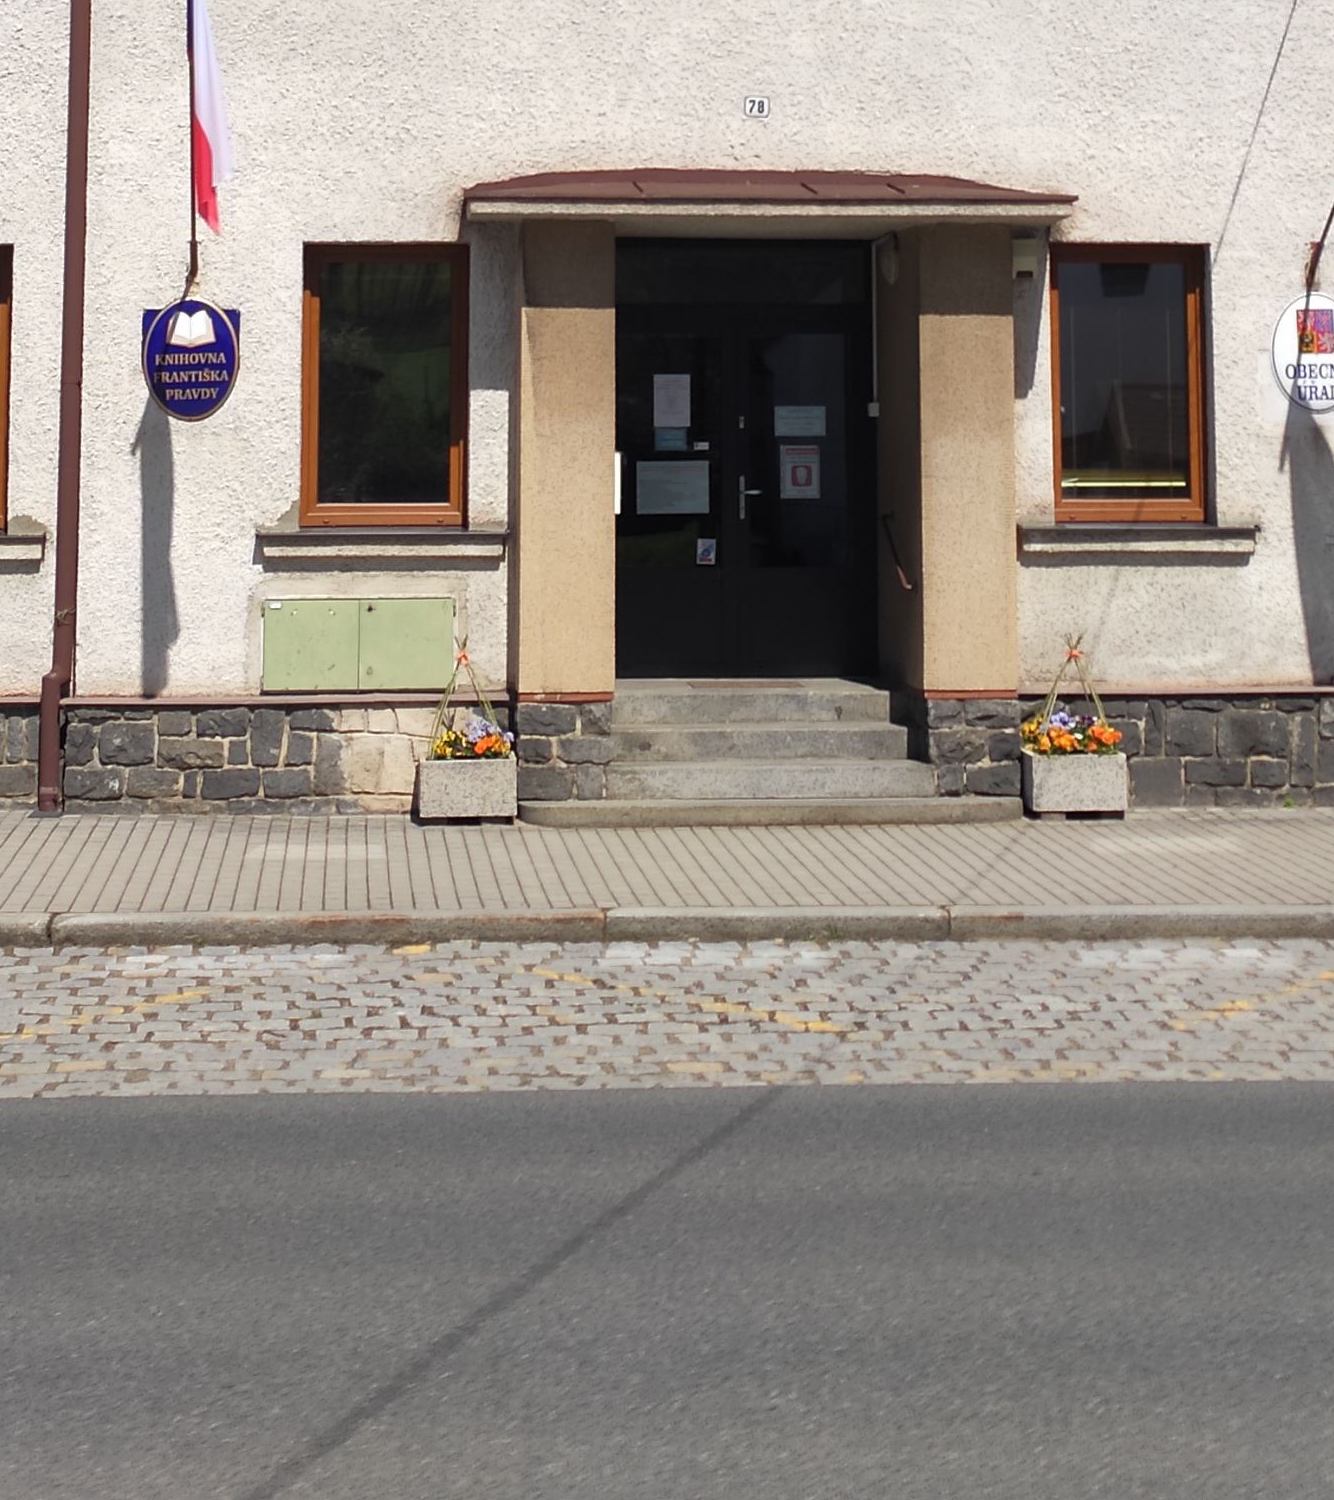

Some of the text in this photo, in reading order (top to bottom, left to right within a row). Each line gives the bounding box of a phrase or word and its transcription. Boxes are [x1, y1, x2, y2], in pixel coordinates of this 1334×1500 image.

[748, 99, 765, 114] 78
[154, 352, 227, 366] KNIHOVNA
[153, 368, 229, 383] FRANTIŠKA
[165, 387, 220, 401] PRAVDY
